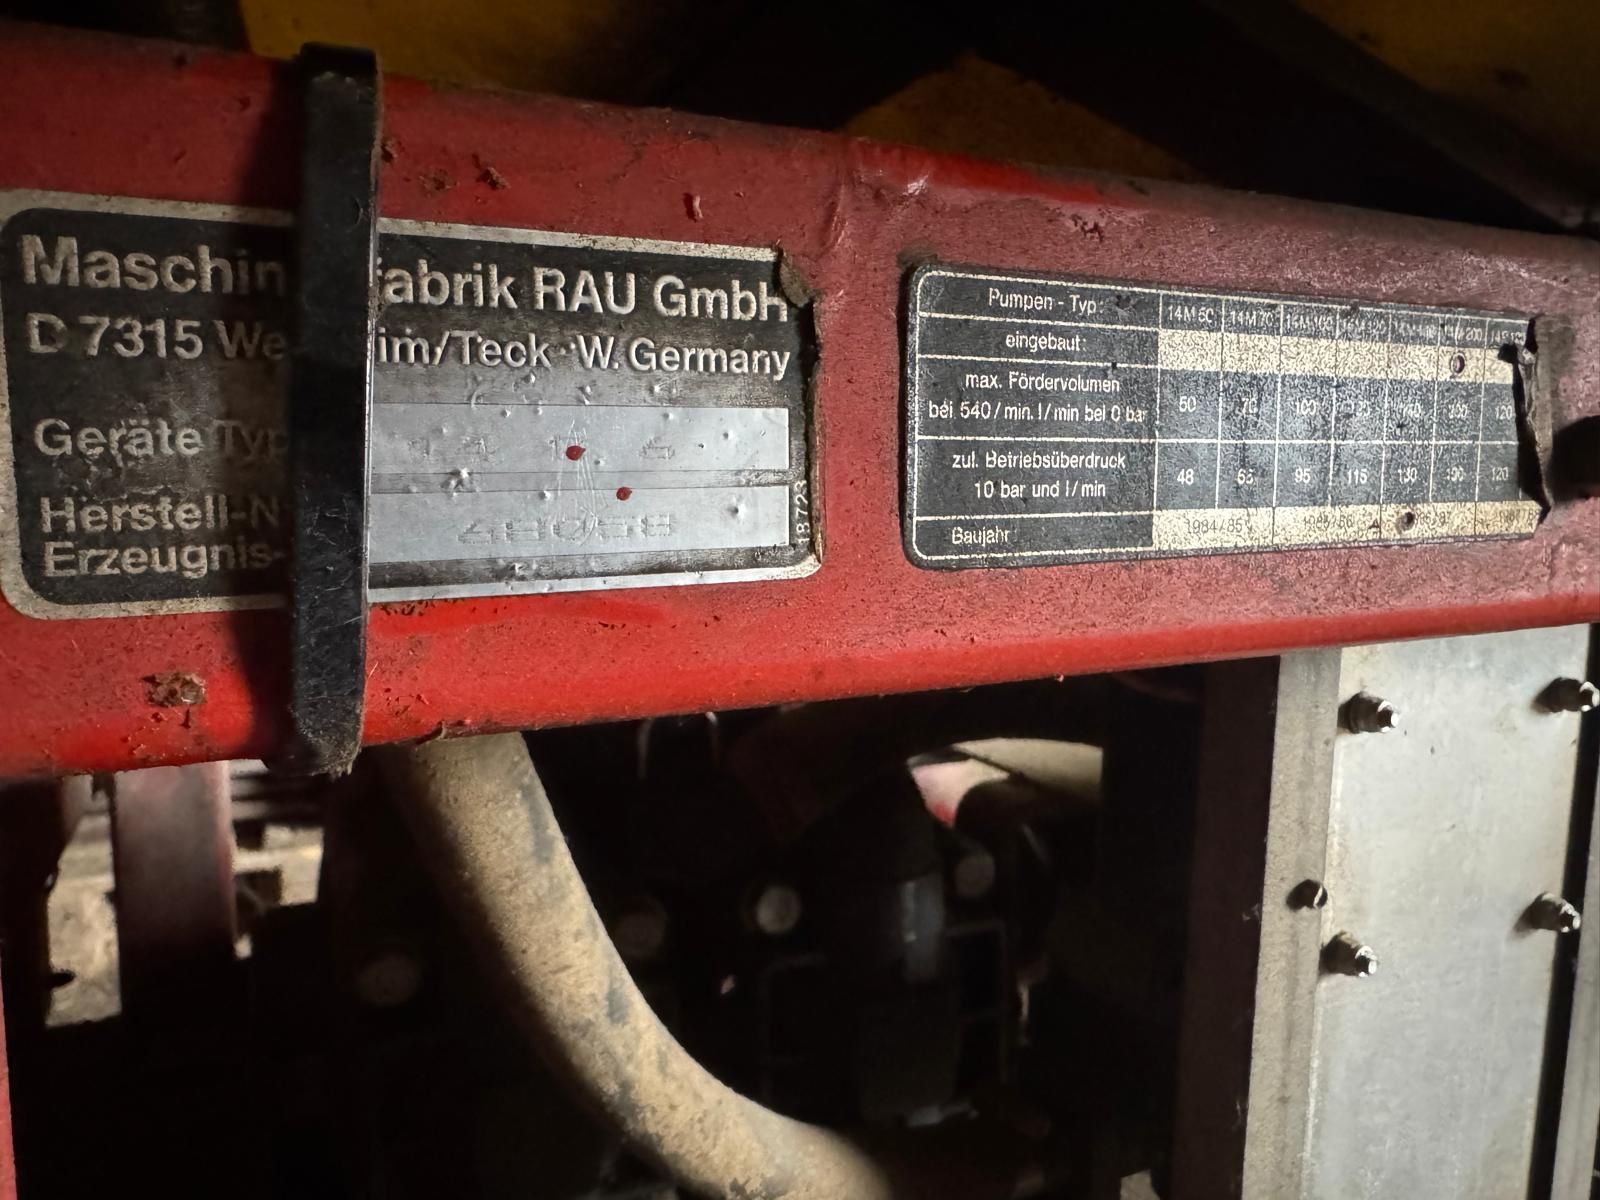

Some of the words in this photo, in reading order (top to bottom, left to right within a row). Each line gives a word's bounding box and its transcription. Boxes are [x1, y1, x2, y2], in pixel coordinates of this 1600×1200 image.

[533, 266, 635, 314] RAU
[653, 274, 788, 323] Gmbh
[989, 287, 1052, 312] Pumpen
[26, 312, 68, 353] D
[78, 316, 203, 359] 7315
[629, 337, 790, 381] Germany
[965, 374, 1002, 389] max.
[1009, 371, 1120, 392] Fördervolumen
[1495, 405, 1513, 420] 120
[33, 416, 203, 459] Geräte
[952, 451, 978, 469] zul.
[985, 450, 1126, 469] Betriebsüberdruck
[1176, 468, 1195, 486] 48
[1294, 468, 1311, 484] 95
[974, 480, 994, 499] 10
[1000, 480, 1026, 499] bar
[1032, 480, 1060, 498] und
[40, 496, 284, 534] Herstell-N
[952, 526, 1010, 546] Baujahr
[43, 535, 288, 580] Erzeugnis-
